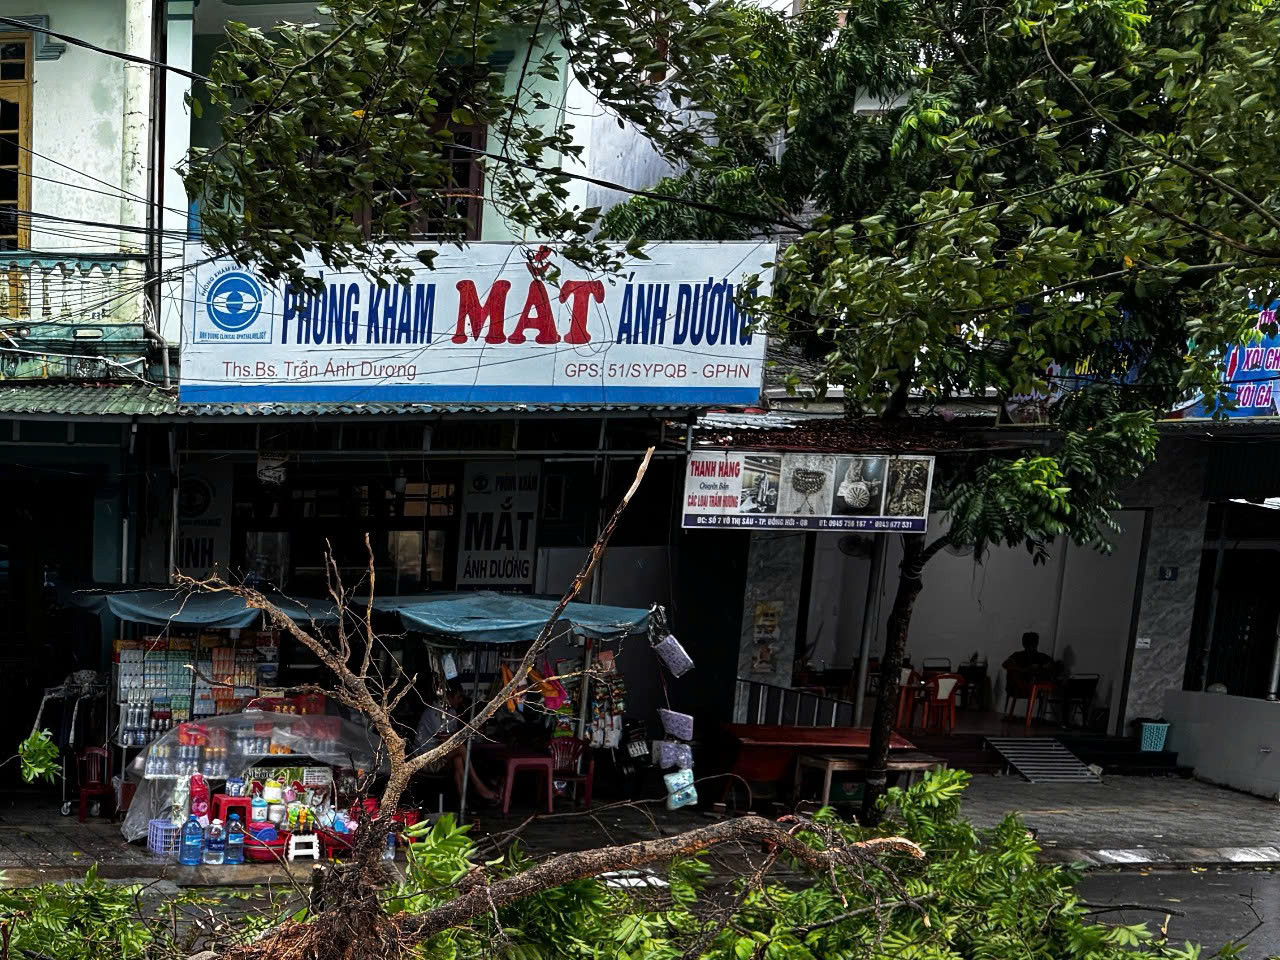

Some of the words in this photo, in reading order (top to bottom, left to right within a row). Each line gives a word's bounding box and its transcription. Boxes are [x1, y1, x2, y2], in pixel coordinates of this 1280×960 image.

[281, 271, 360, 345] PHÒNG
[451, 245, 605, 345] MẮT
[616, 272, 670, 345] ÁNH
[222, 361, 278, 377] Ths.Bs.
[323, 357, 355, 377] Ánh
[361, 361, 417, 380] Dương
[565, 363, 603, 378] GPS:
[608, 363, 687, 378] 51/SYPQB
[702, 363, 750, 378] GPHN
[691, 460, 716, 477] THANH
[464, 496, 534, 551] MẮT
[463, 555, 487, 578] ÁNH
[489, 556, 529, 579] DƯƠNG
